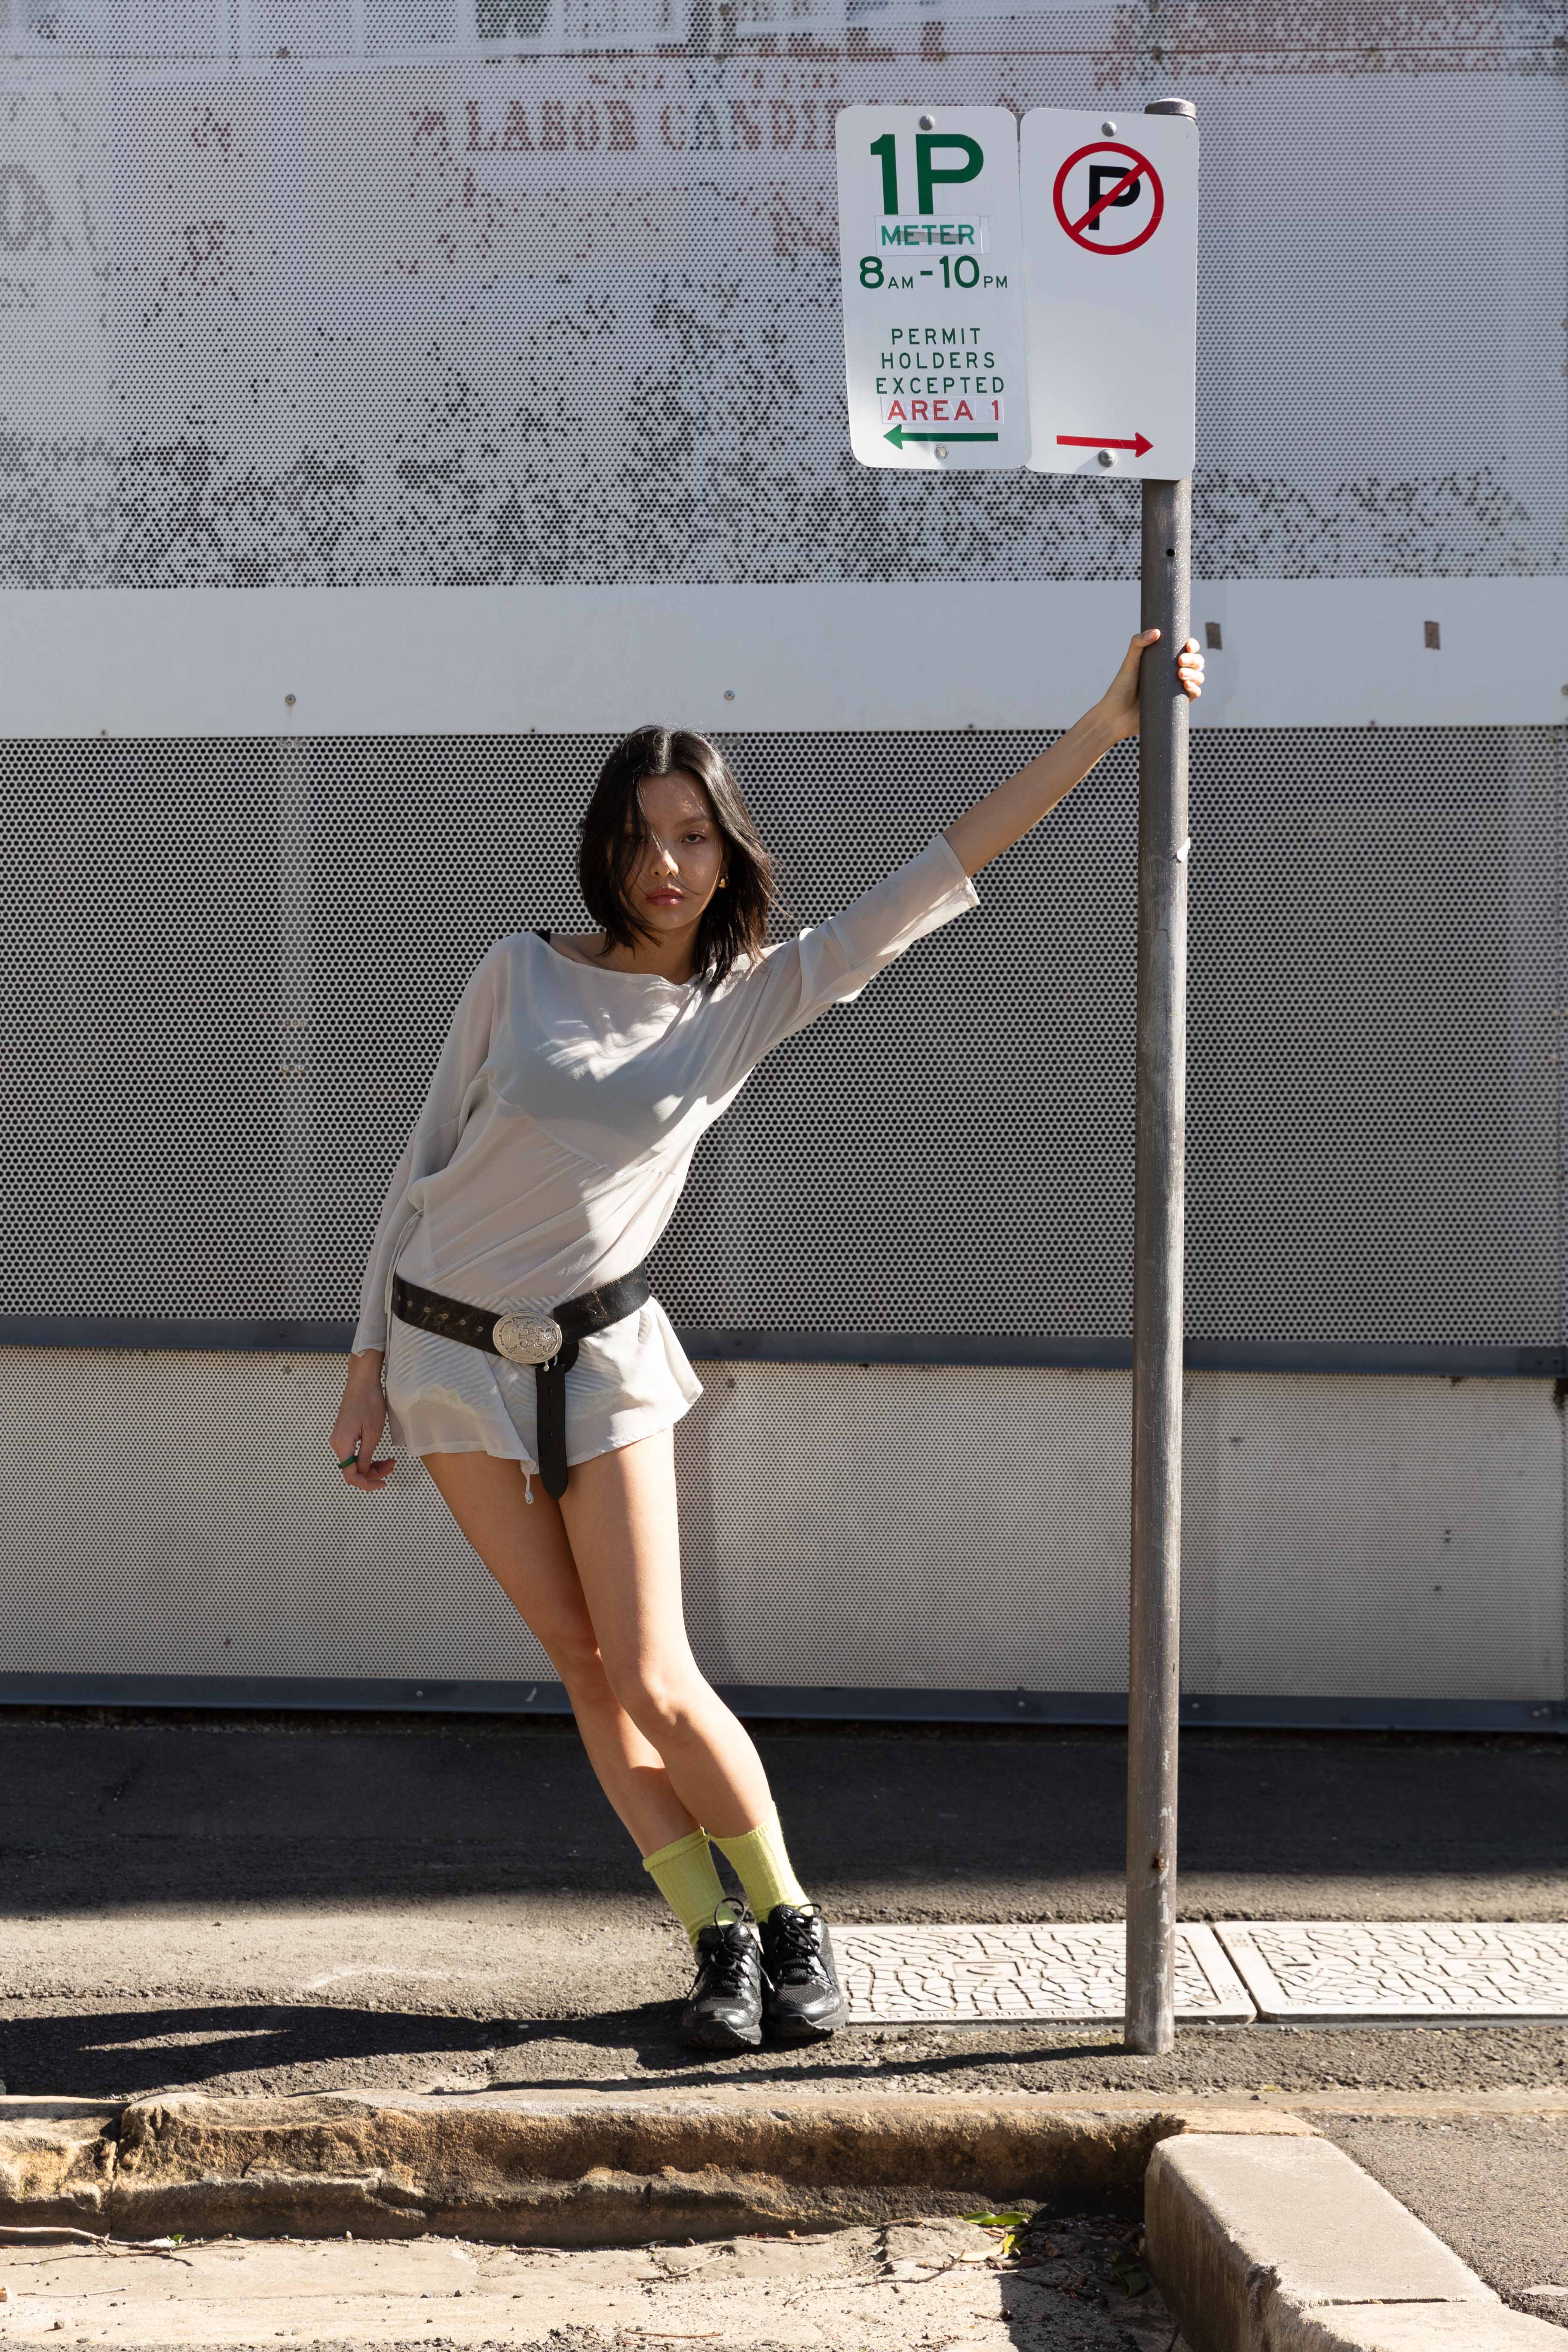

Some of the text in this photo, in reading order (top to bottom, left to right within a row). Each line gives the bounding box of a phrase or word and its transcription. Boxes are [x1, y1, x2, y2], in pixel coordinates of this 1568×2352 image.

[870, 134, 984, 215] 1P
[881, 224, 975, 246] METER
[891, 328, 981, 345] PERMIT
[881, 352, 995, 369] HOLDERS
[876, 377, 1004, 394] EXCEPTED
[888, 400, 999, 421] AREA 1
